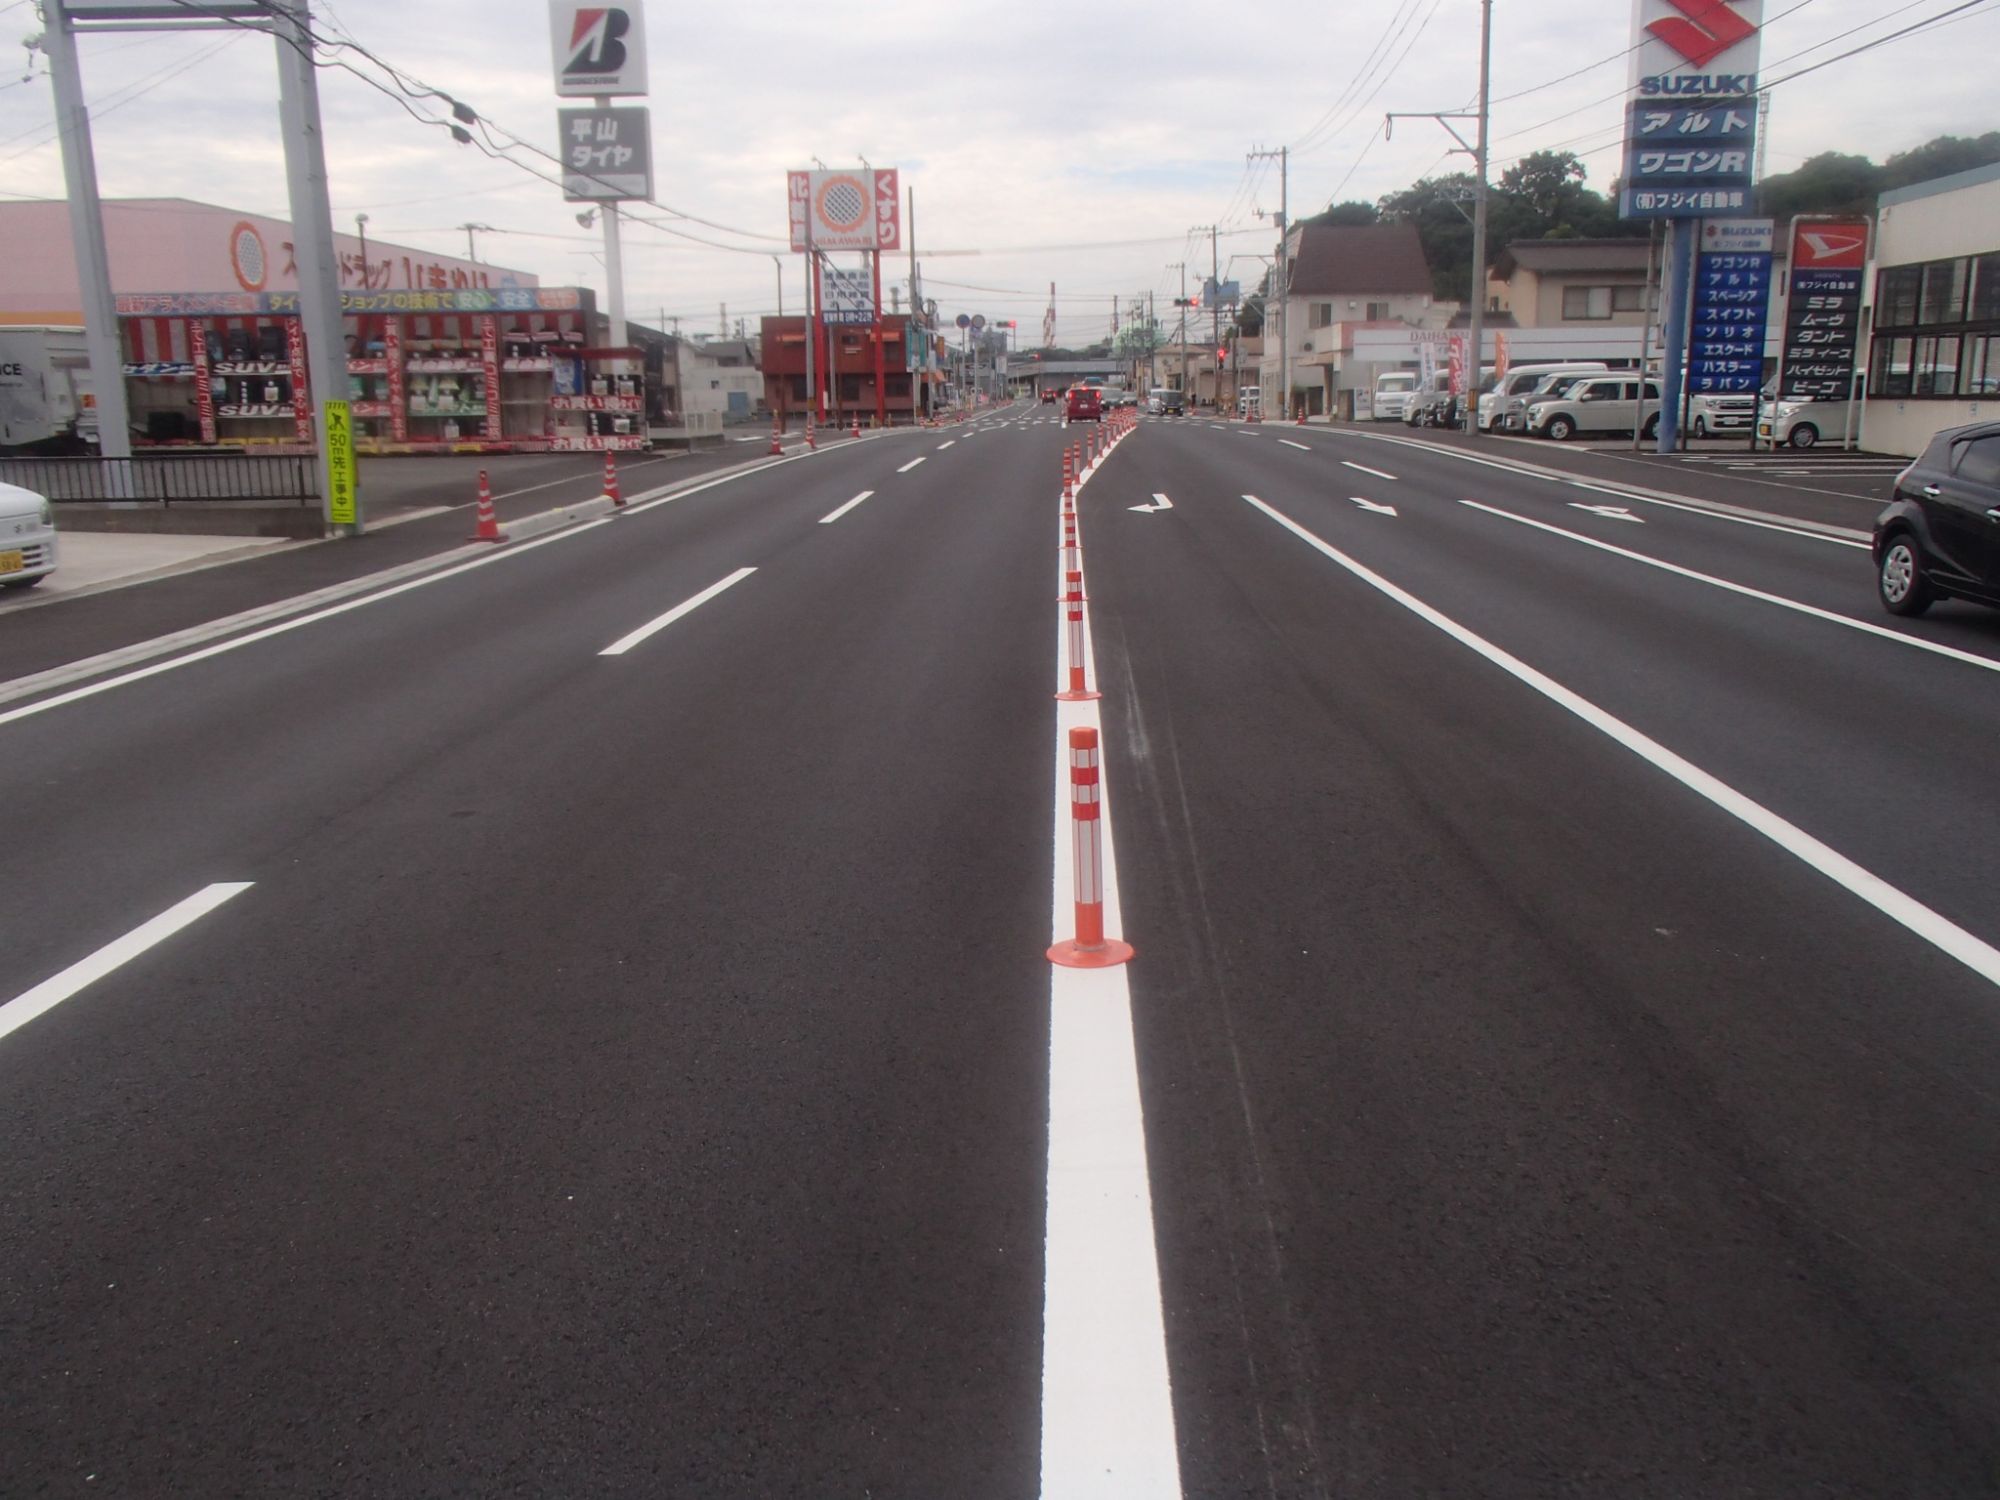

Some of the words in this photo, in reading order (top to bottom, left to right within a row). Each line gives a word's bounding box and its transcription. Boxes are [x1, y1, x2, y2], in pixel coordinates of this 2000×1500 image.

[1639, 74, 1757, 95] SUZUKI
[1642, 109, 1749, 133] アルト
[571, 118, 619, 142] 平山
[571, 145, 633, 168] タイヤ
[1639, 151, 1747, 174] ワゴンR
[876, 173, 897, 245] くすり
[1710, 256, 1760, 269] ワゴンR
[1709, 272, 1759, 286] アルト
[1708, 289, 1758, 302] スペーシア
[1806, 296, 1843, 309] ミラ
[1706, 308, 1756, 321] スイフト
[1705, 326, 1755, 338] ソリオ
[1797, 330, 1846, 343] タント
[1703, 344, 1753, 356] エスクード
[213, 362, 275, 374] SUV
[1702, 361, 1752, 373] ハスラー
[1786, 365, 1851, 376] ハイゼット
[218, 404, 279, 416] SUV
